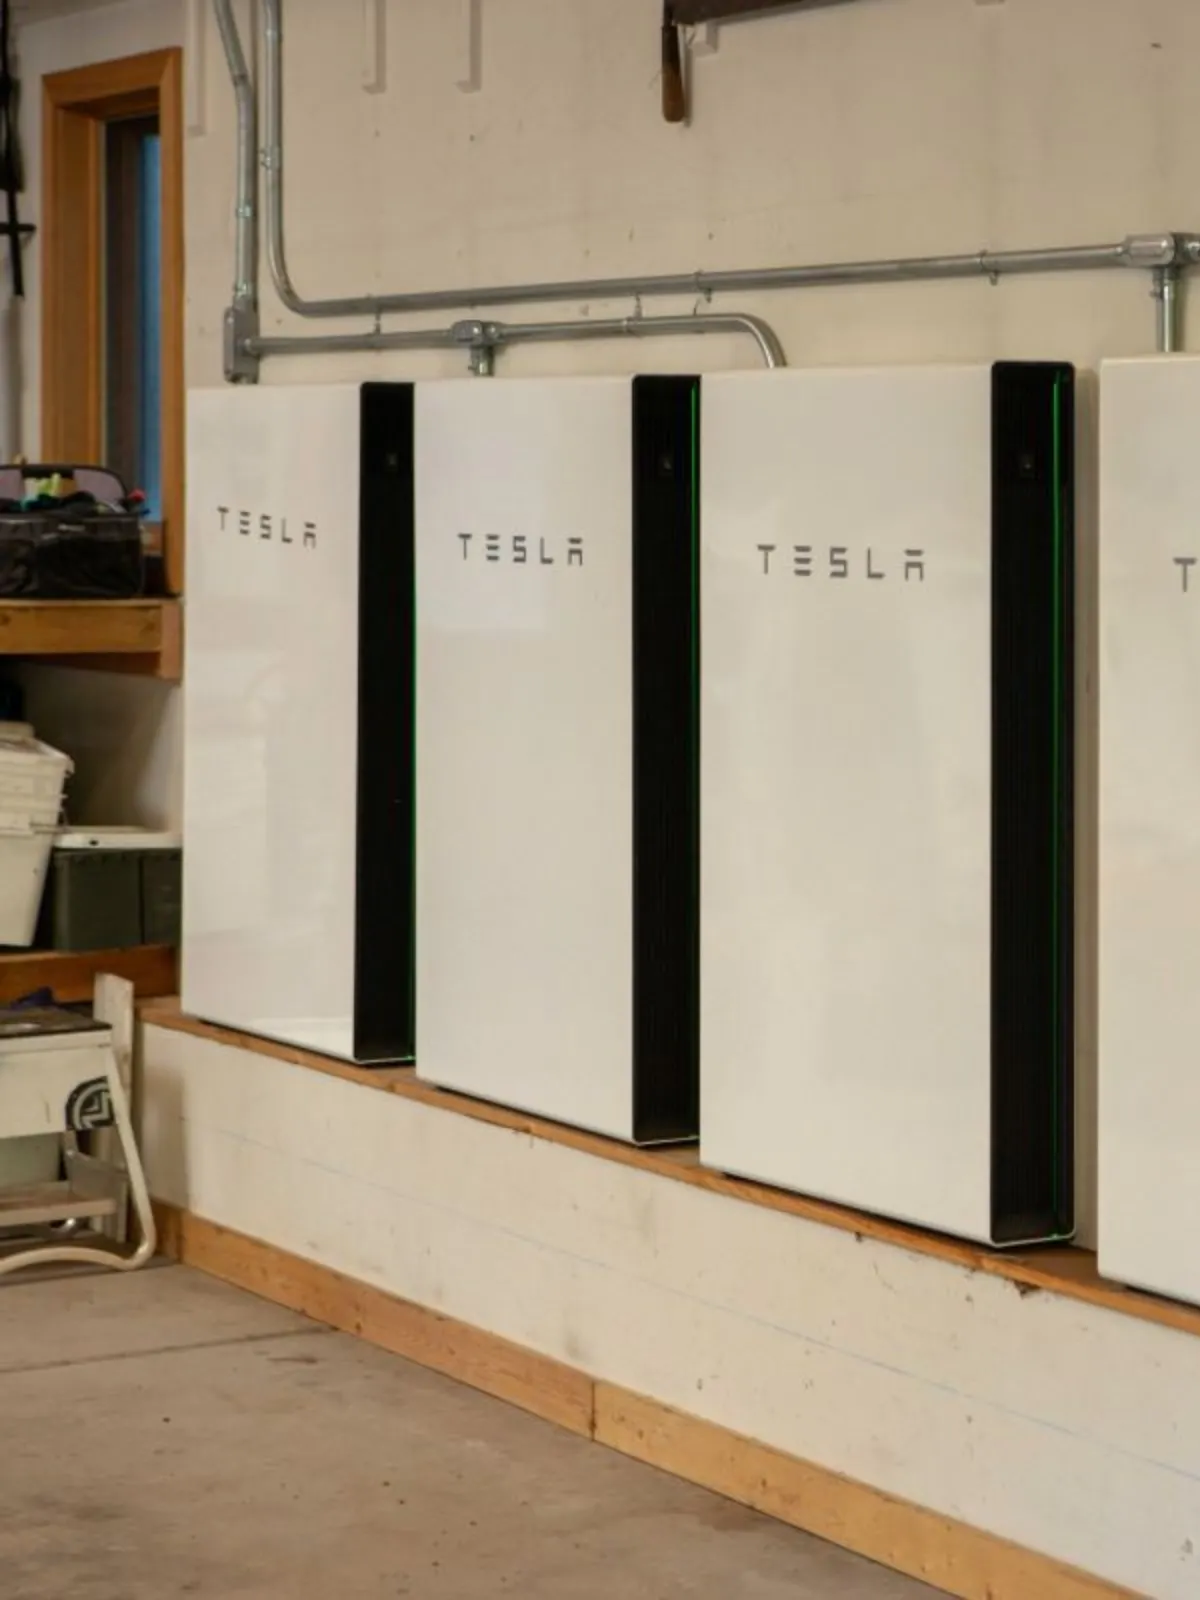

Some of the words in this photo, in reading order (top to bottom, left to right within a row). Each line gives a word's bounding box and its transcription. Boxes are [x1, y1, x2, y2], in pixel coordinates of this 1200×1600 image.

[217, 506, 317, 549] TESLA
[457, 532, 584, 567] TESLA
[757, 543, 926, 582] TESLA
